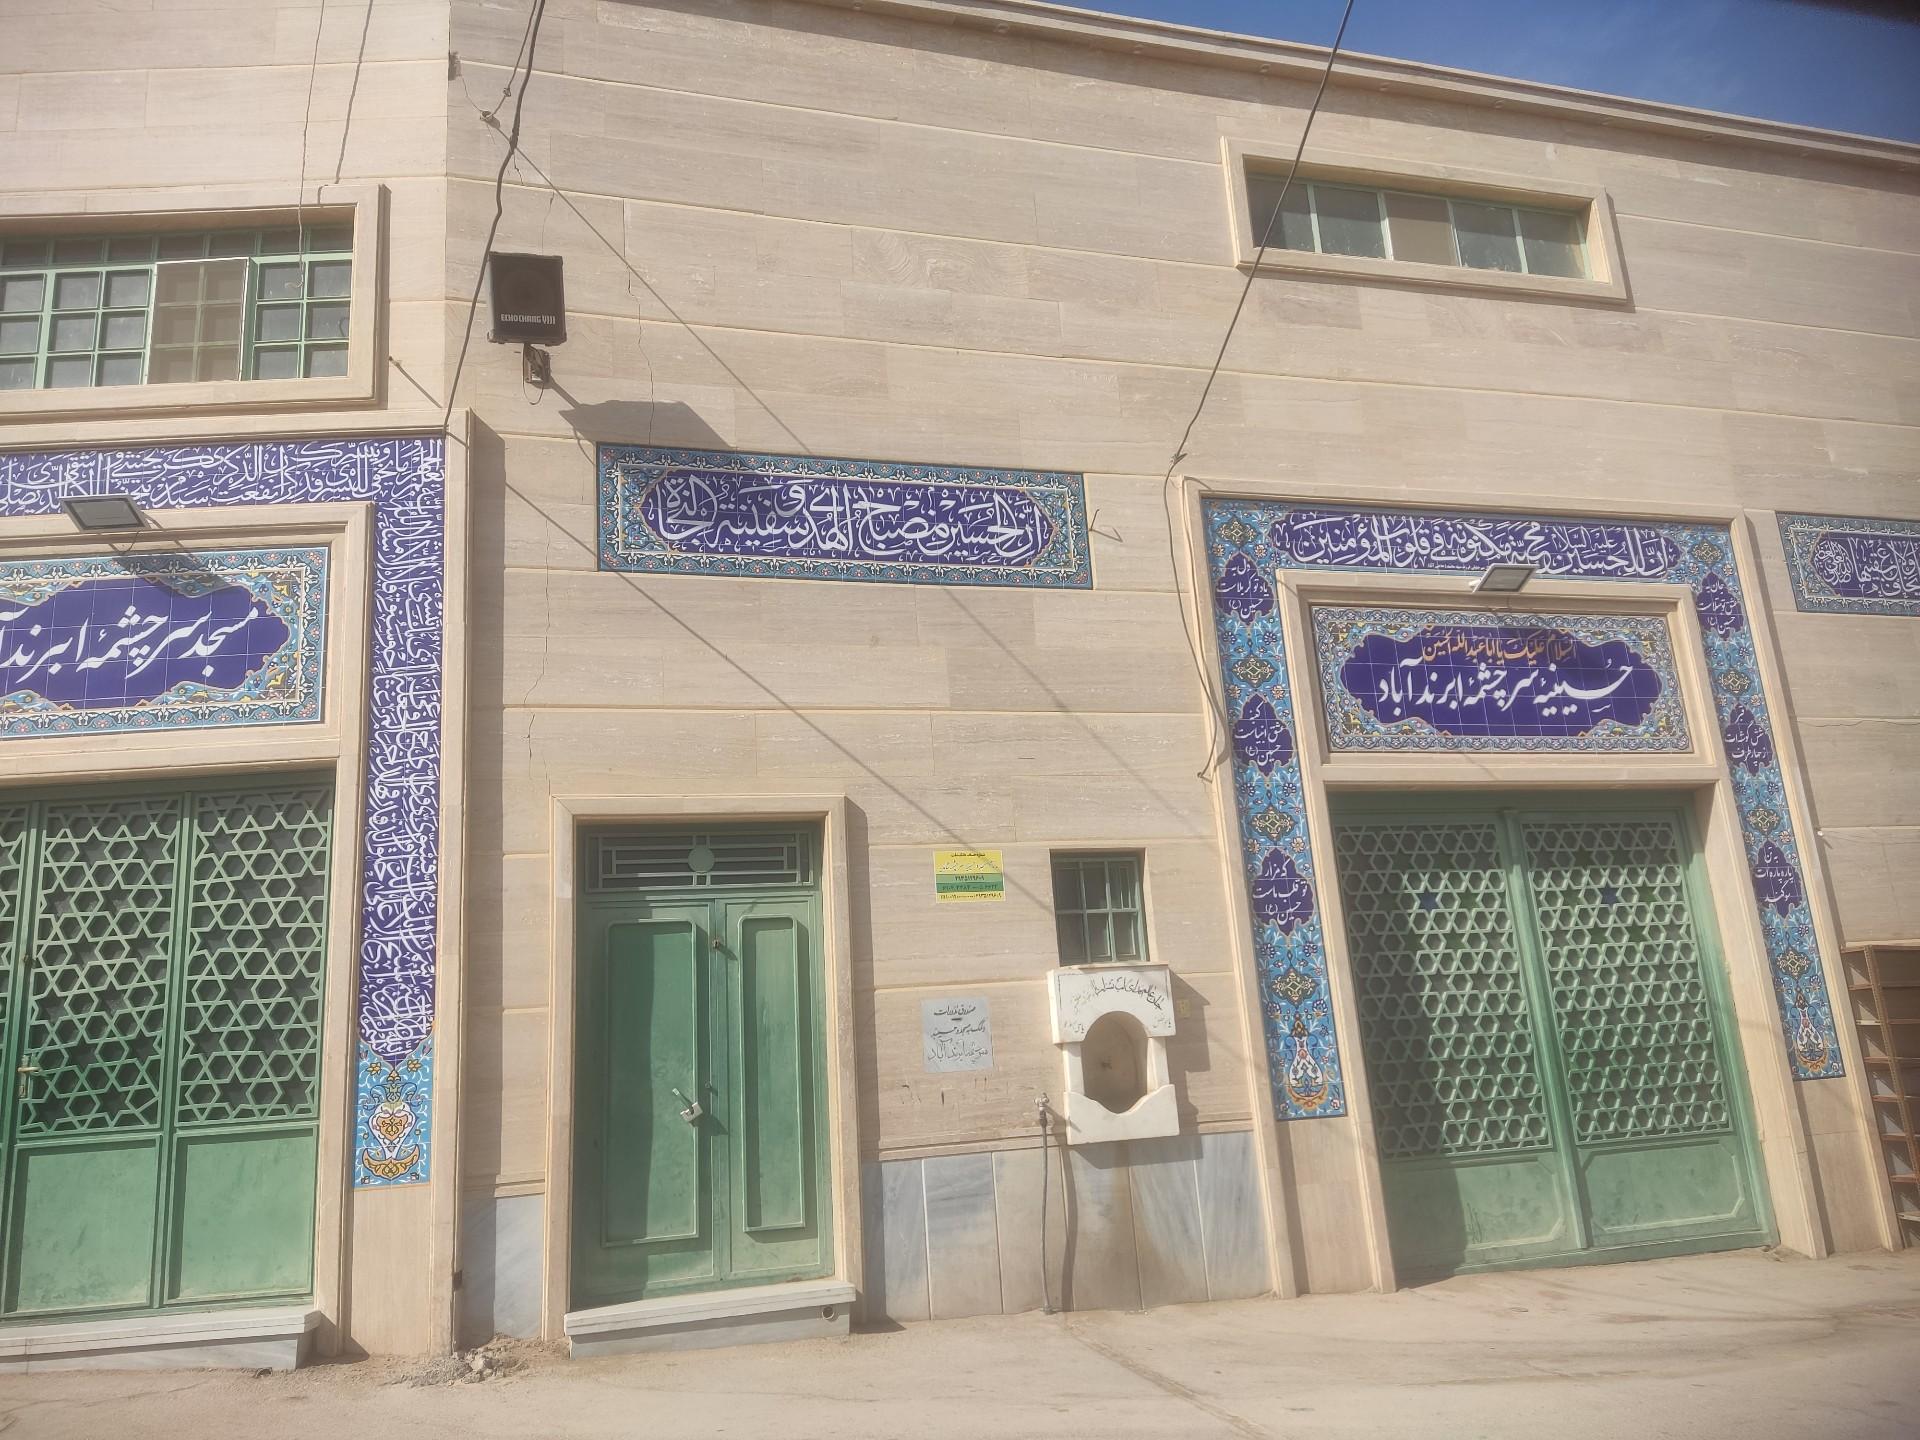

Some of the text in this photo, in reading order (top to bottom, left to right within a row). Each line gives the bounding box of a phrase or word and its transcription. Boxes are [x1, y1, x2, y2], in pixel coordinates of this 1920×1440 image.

[1237, 558, 1250, 575] دل
[1240, 599, 1263, 619] حسین
[1717, 616, 1736, 634] حسین
[177, 607, 258, 677] مسجد
[1257, 744, 1281, 766] حسین
[1265, 861, 1280, 881] مزار
[1278, 879, 1300, 902] قلب
[1277, 901, 1301, 925] حسین
